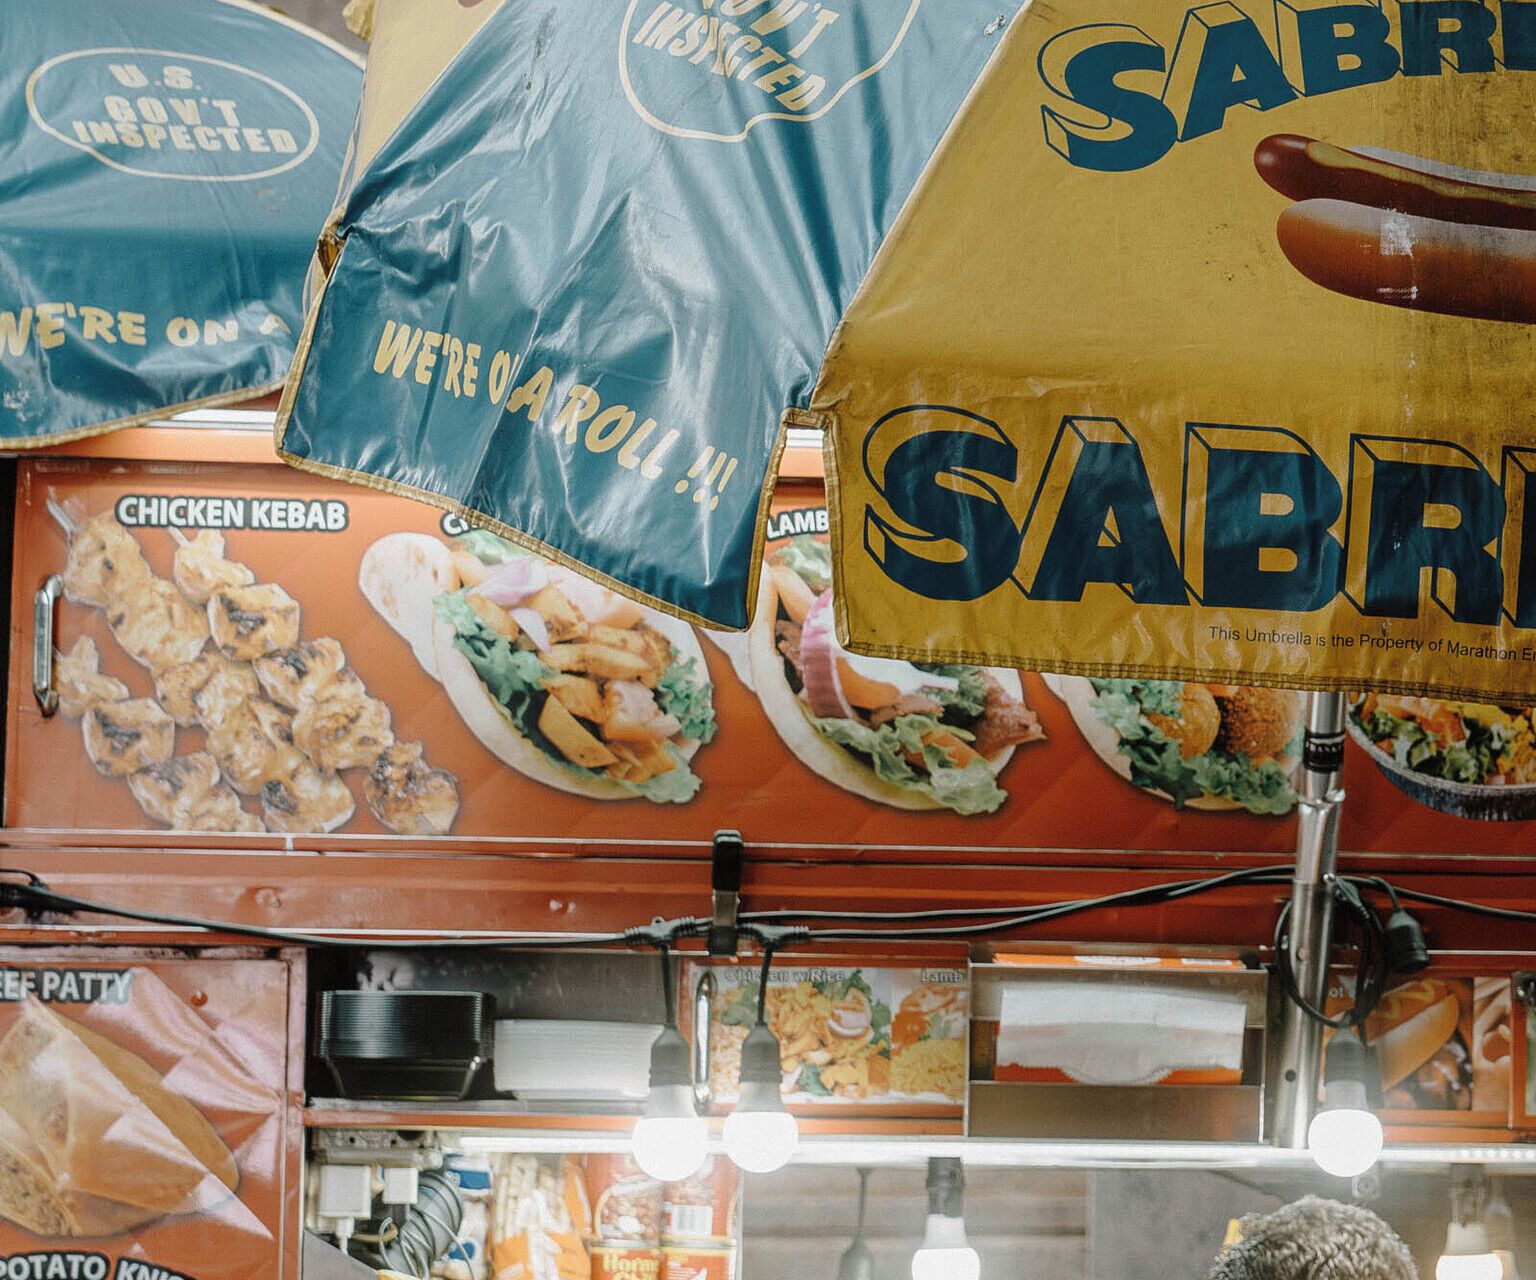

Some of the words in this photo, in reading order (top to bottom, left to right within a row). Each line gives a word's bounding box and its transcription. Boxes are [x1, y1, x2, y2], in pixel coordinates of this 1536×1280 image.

[632, 1, 827, 111] INSPECTED
[108, 64, 202, 90] U.S.
[104, 96, 240, 127] GOV'T
[72, 121, 298, 153] INSPECTED
[166, 317, 238, 346] ON
[373, 320, 481, 398] WE'RE
[488, 350, 520, 404] O
[506, 366, 553, 422] A
[552, 384, 680, 479] ROLL
[674, 446, 738, 510] !!!
[119, 497, 248, 528] CHICKEN
[252, 500, 345, 530] KEBAB
[766, 510, 829, 538] LAMB
[1210, 625, 1240, 641] This
[1246, 627, 1311, 646] Umbrella
[1315, 632, 1327, 647] is
[1331, 632, 1354, 648] the
[1360, 634, 1424, 653] Property
[1428, 637, 1443, 651] of
[1448, 640, 1517, 661] Marathon
[0, 971, 36, 1000] EF
[42, 970, 130, 1001] PATTY
[921, 970, 964, 984] Lamb
